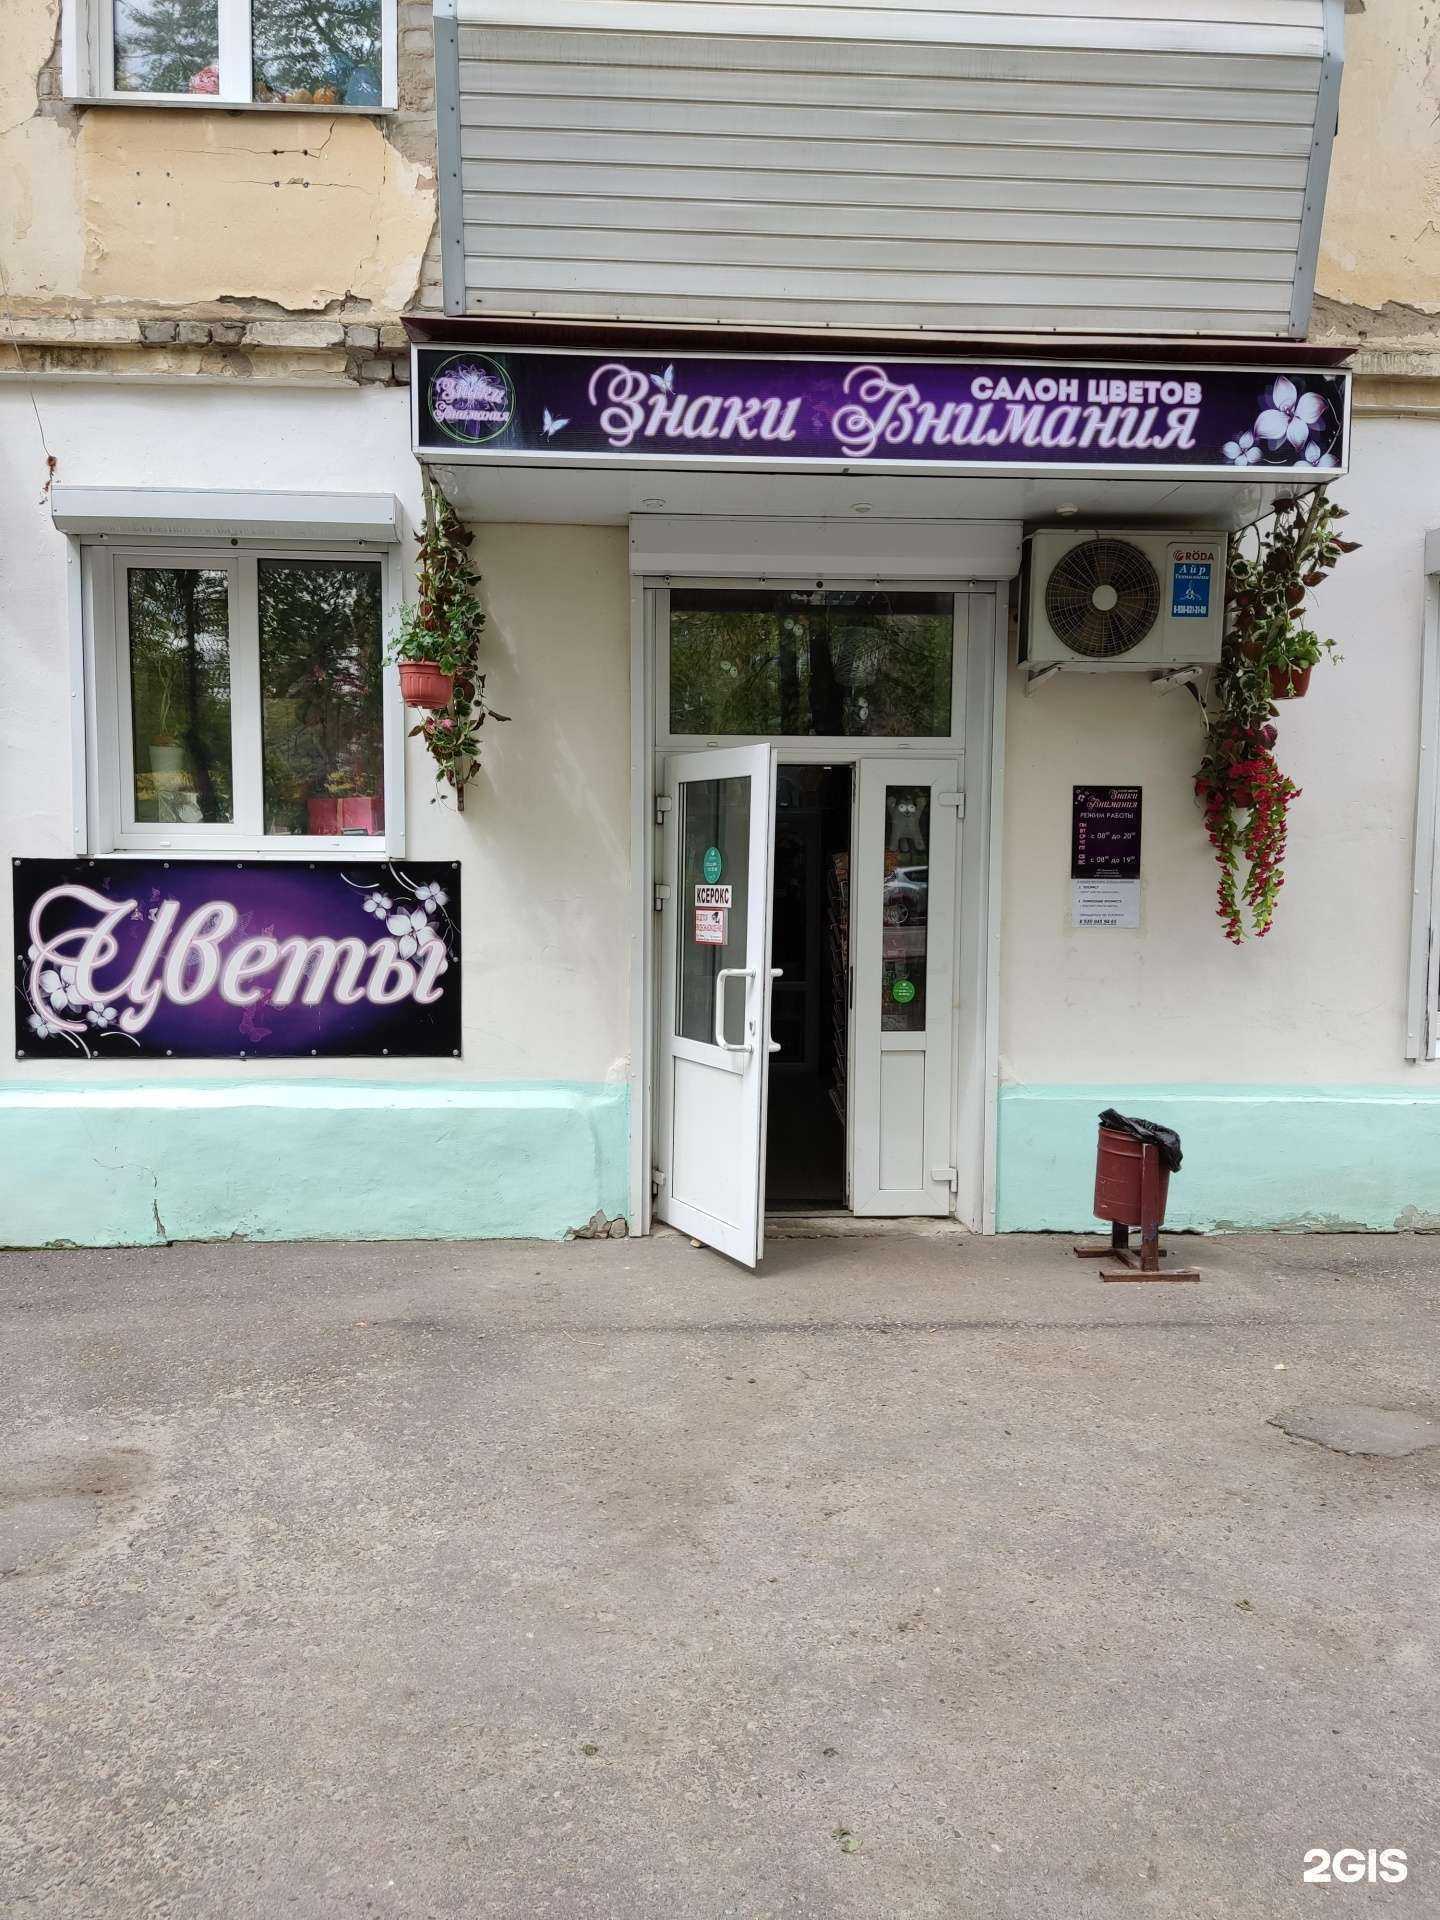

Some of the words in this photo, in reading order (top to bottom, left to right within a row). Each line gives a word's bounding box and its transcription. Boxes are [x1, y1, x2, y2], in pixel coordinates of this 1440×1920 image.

[970, 376, 1079, 403] САЛОН
[1087, 378, 1203, 406] ЦВЕТОВ
[588, 363, 802, 448] Знаки
[831, 365, 1200, 457] Внимания
[1185, 550, 1215, 561] RÖDA
[696, 887, 730, 904] КСЕРОКС
[28, 884, 449, 1033] Цветы
